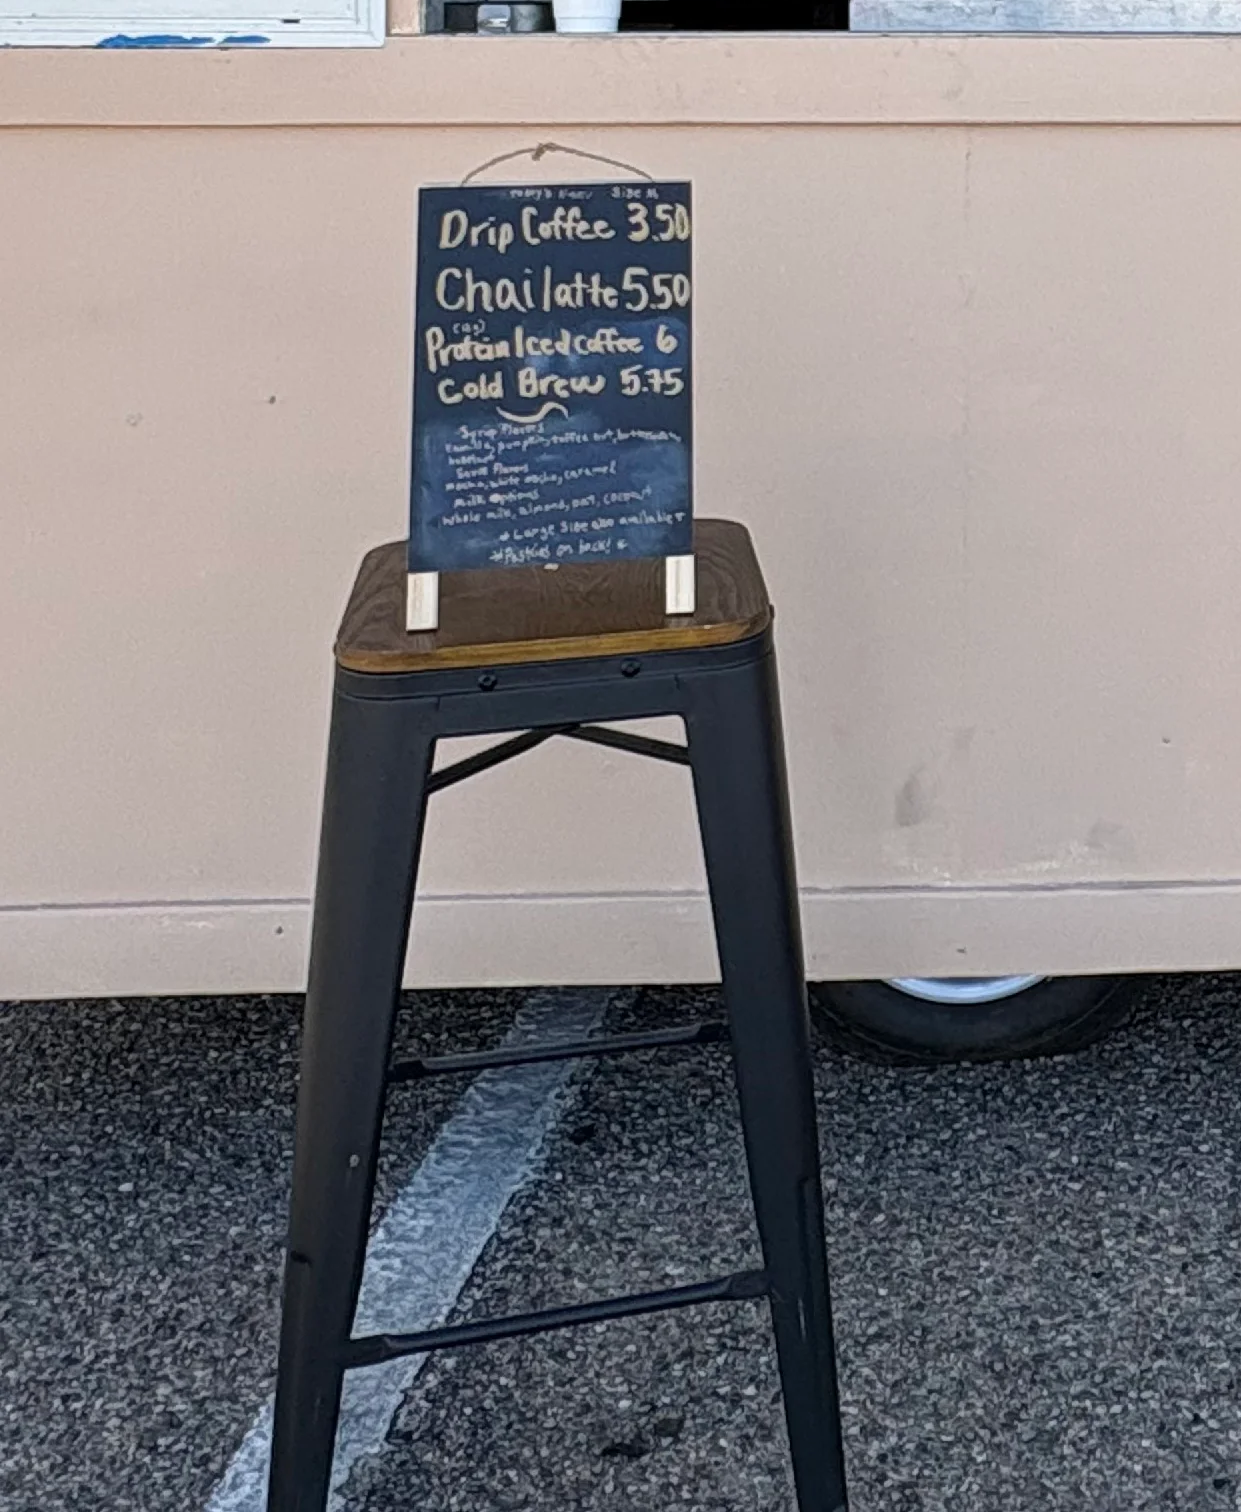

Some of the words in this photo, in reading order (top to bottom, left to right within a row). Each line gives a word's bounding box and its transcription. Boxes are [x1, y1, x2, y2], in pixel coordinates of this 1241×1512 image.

[439, 209, 514, 254] Drip
[522, 206, 616, 245] Coffee
[626, 202, 691, 242] 3.50
[435, 267, 535, 313] Chai
[543, 265, 620, 312] latte
[622, 266, 691, 312] 5.50
[515, 325, 572, 358] Iced
[656, 324, 678, 354] 6
[437, 370, 503, 404] Cold
[518, 366, 606, 398] Brew
[620, 364, 684, 395] 5.75
